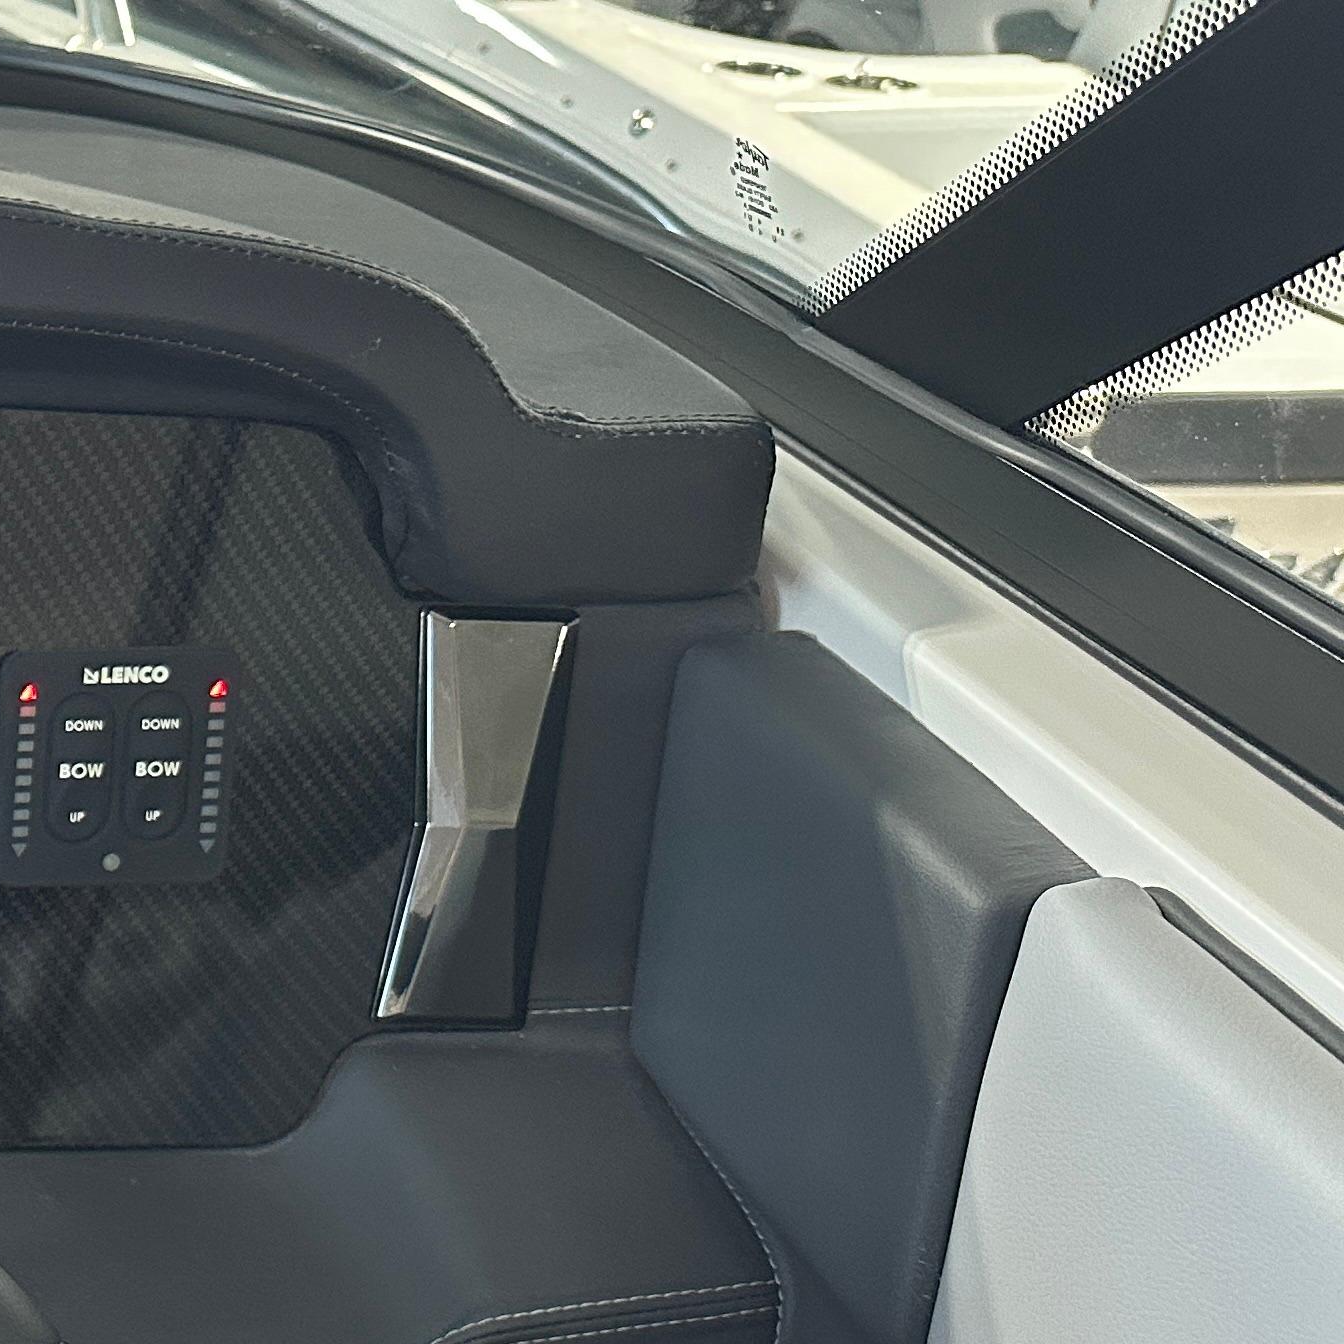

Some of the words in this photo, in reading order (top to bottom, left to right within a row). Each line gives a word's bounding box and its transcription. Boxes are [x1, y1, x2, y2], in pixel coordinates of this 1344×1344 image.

[101, 665, 170, 684] LENCO
[65, 720, 104, 732] DOWN
[141, 718, 180, 730] DOWN
[59, 763, 104, 779] BOW
[135, 761, 180, 777] BOW
[69, 811, 86, 823] UP
[145, 809, 161, 822] UP
